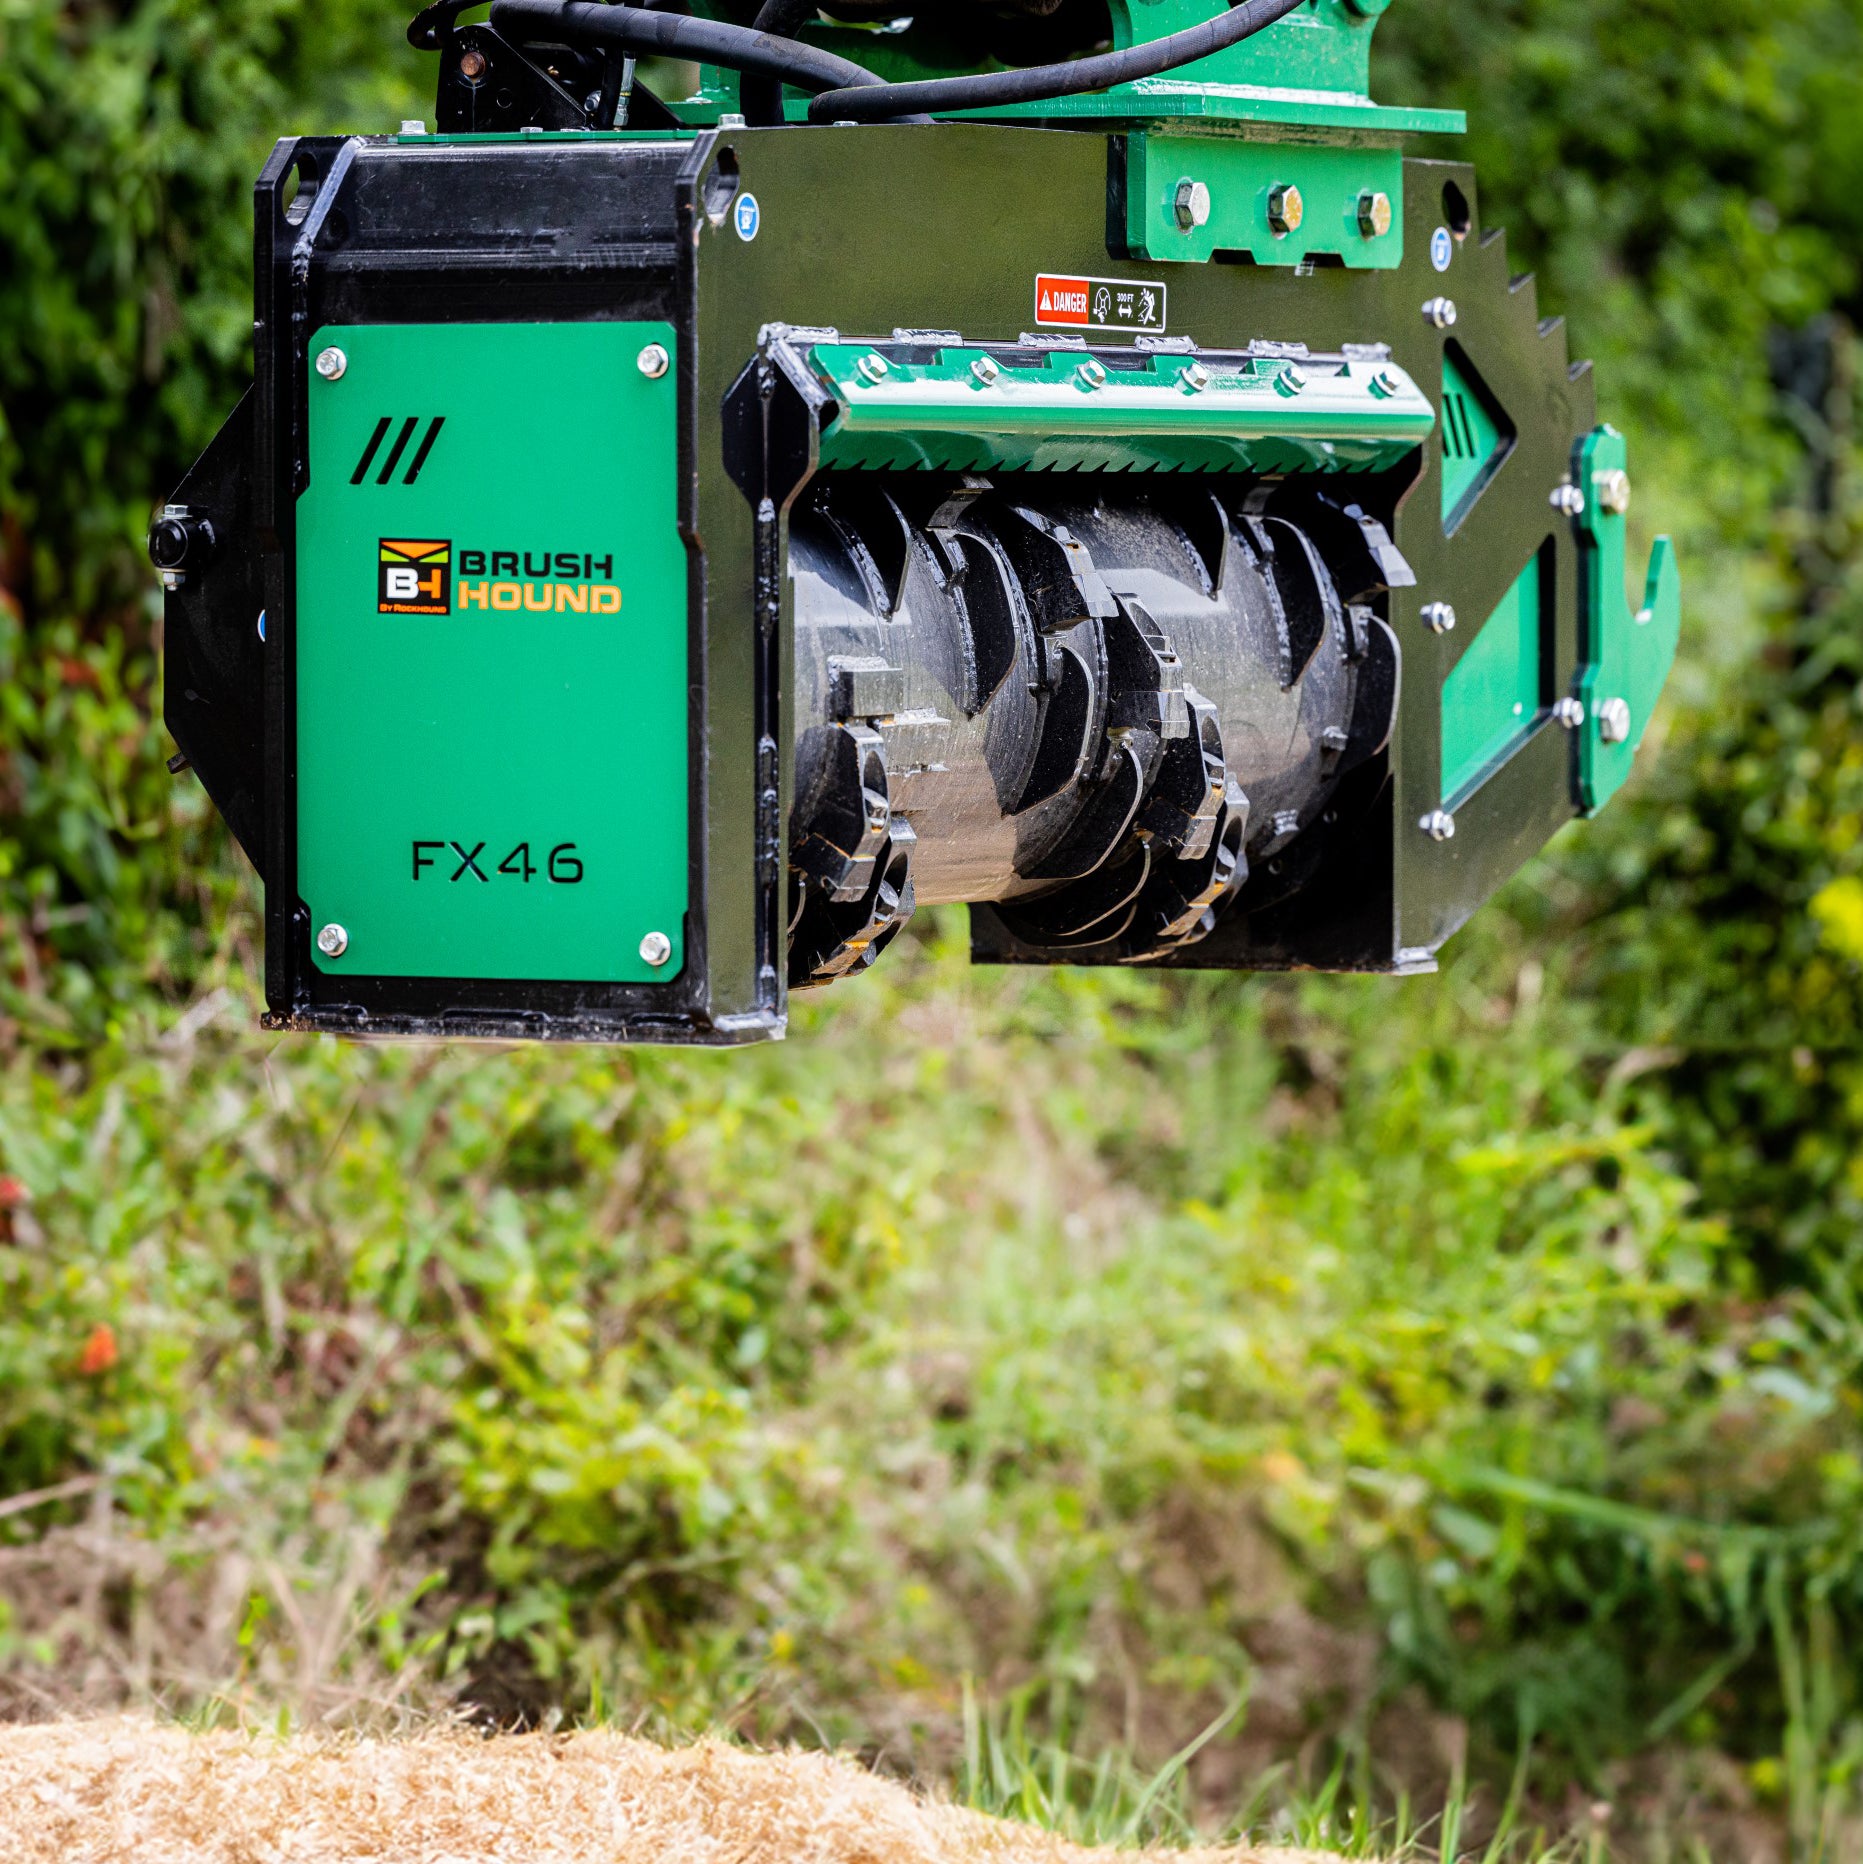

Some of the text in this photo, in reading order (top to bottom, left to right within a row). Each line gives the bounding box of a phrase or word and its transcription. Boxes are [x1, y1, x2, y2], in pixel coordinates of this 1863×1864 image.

[1053, 291, 1087, 313] DANGER
[459, 550, 613, 580] BRUSH
[386, 567, 442, 599] BH
[457, 581, 622, 614] HOUND
[412, 841, 583, 884] FX46
